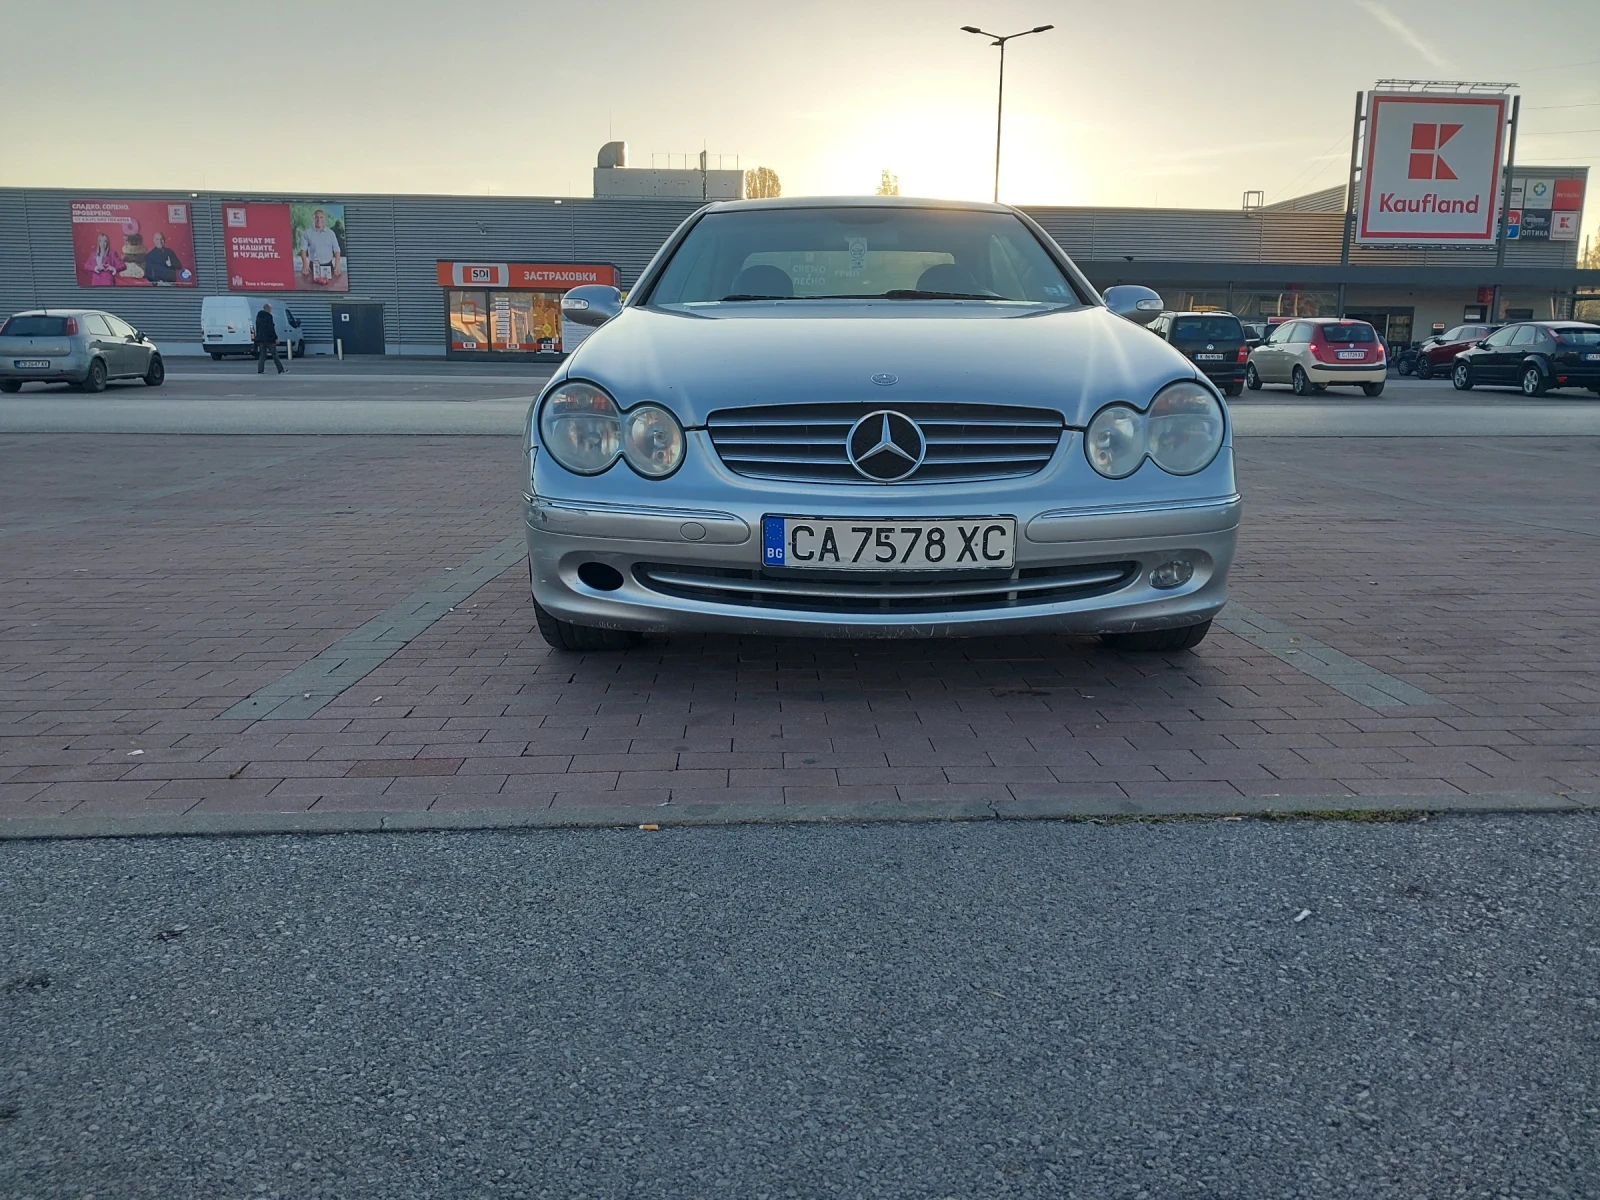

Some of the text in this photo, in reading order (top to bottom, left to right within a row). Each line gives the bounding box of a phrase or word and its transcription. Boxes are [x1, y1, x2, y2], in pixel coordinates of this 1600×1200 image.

[1379, 193, 1480, 214] Kaufland
[240, 244, 275, 252] НАШИТЕ,
[240, 251, 281, 259] ЧУЖДИТЕ.
[472, 269, 489, 278] SDI
[792, 265, 826, 273] СВЕЖО
[523, 271, 597, 282] ЗАСТРАХОВКИ
[793, 277, 826, 285] ЛЕСНО
[791, 524, 1007, 563] CA 7578 XC
[767, 547, 783, 559] BG
